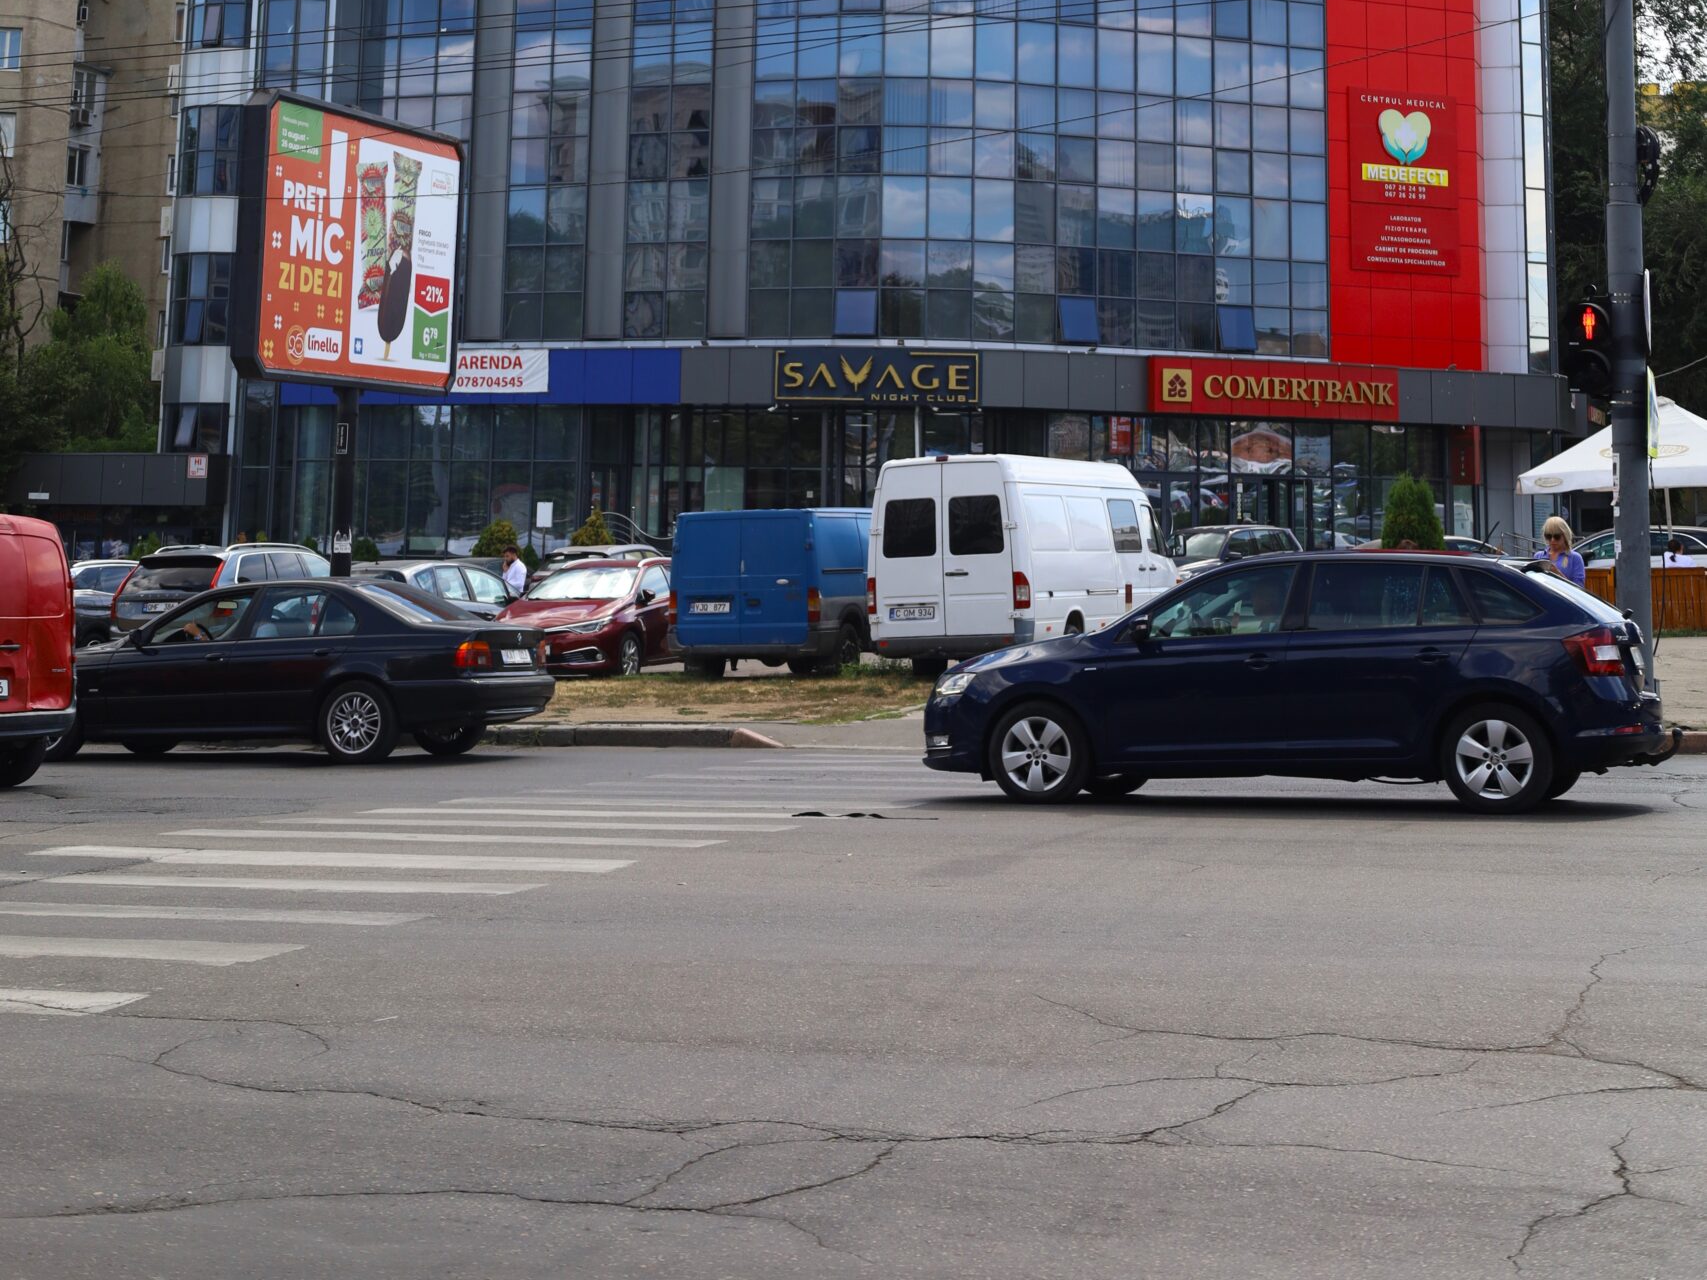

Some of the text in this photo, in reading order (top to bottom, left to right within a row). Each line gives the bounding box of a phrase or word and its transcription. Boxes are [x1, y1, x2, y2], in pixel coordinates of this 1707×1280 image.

[1360, 94, 1446, 110] CENTRUL MEDICAL
[1367, 164, 1446, 185] MEDEFECT
[1389, 215, 1422, 223] LABORATOR
[1384, 225, 1427, 234] FIZIOTERAPIE
[1380, 235, 1431, 245] ULTRASONOGRAFIE
[1407, 248, 1439, 256] PROCEDURI
[278, 261, 343, 299] ZI DE ZI
[420, 285, 444, 304] -21%
[307, 334, 339, 354] linella
[458, 355, 523, 370] ARENDA
[783, 354, 970, 392] SAVAGE
[456, 376, 523, 388] 078704545
[870, 393, 968, 403] NIGHT CLUB
[1203, 375, 1395, 408] COMERȚBANK
[917, 608, 933, 617] 934
